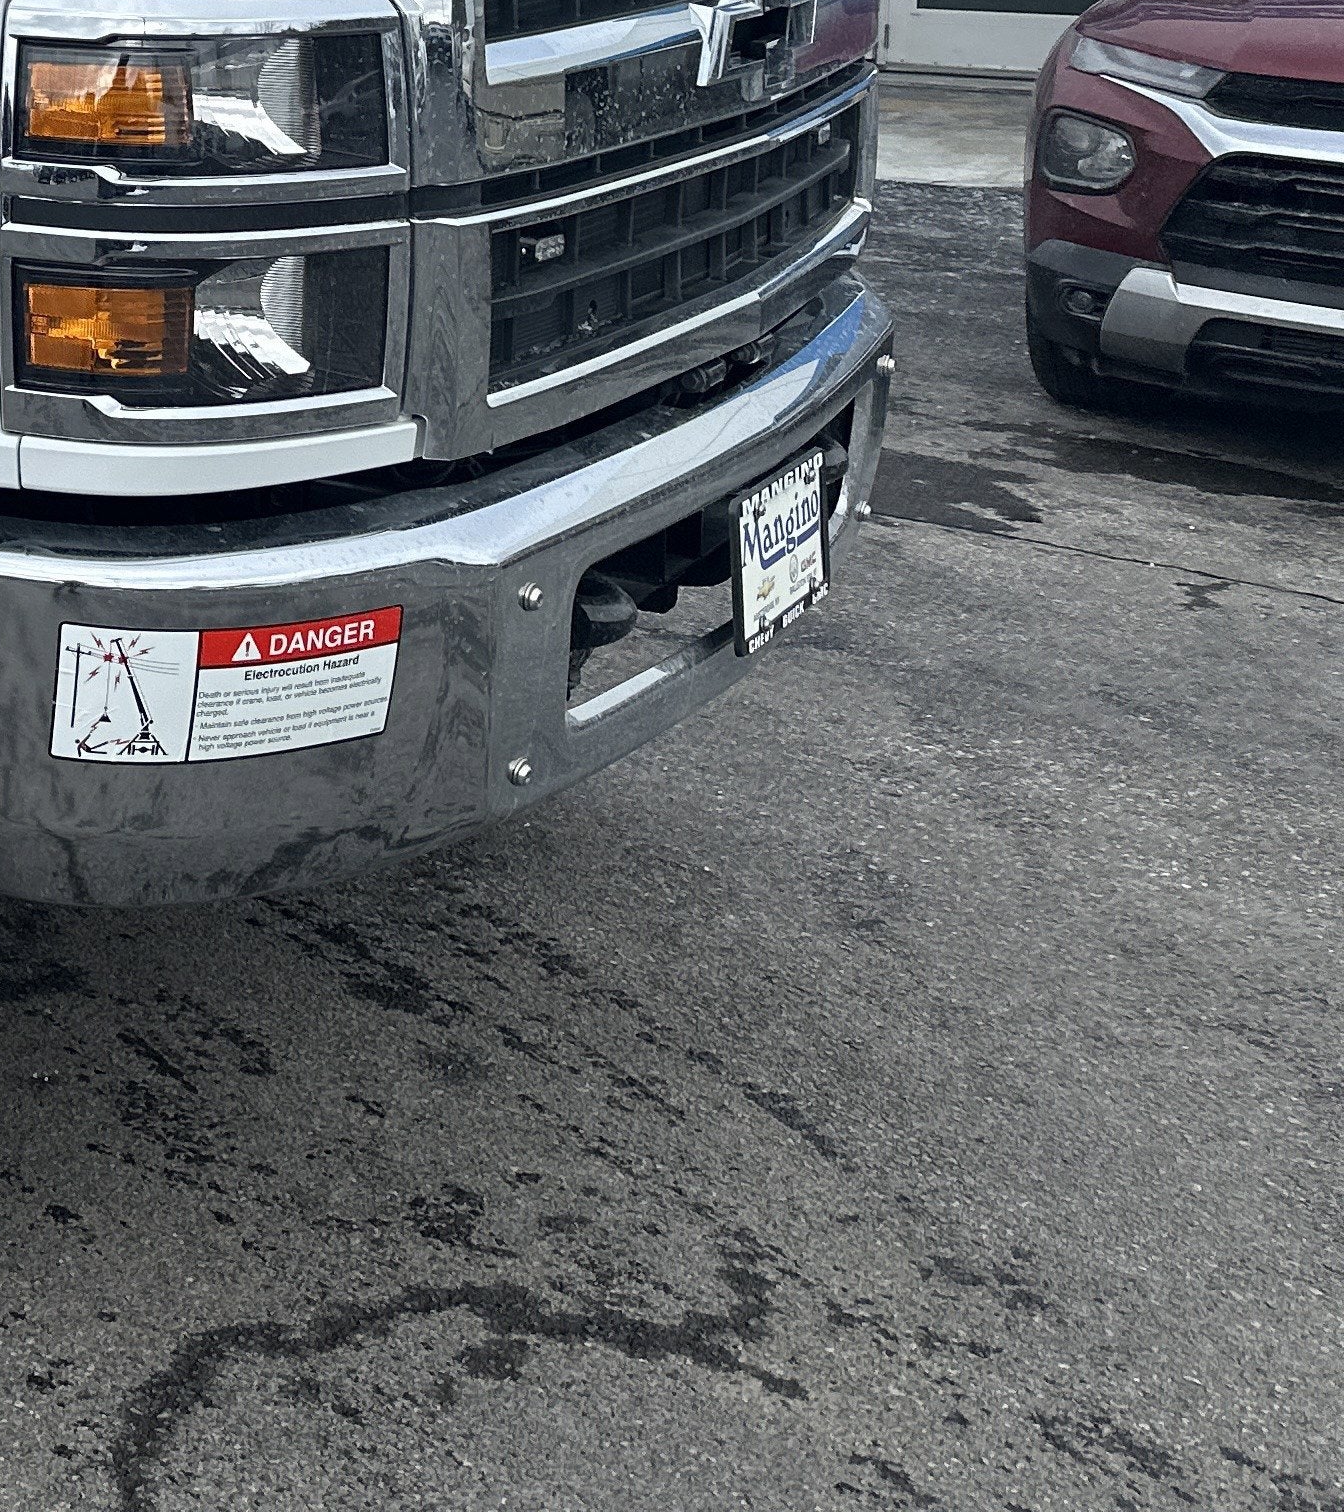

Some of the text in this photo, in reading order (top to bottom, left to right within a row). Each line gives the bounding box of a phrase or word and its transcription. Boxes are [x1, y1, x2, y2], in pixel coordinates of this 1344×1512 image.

[741, 452, 824, 519] MANGINO
[742, 489, 820, 569] Mangino
[268, 619, 376, 657] DANGER
[748, 624, 775, 654] CHEVY
[782, 600, 805, 628] BUICK
[243, 654, 360, 682] Electrocution Hazard
